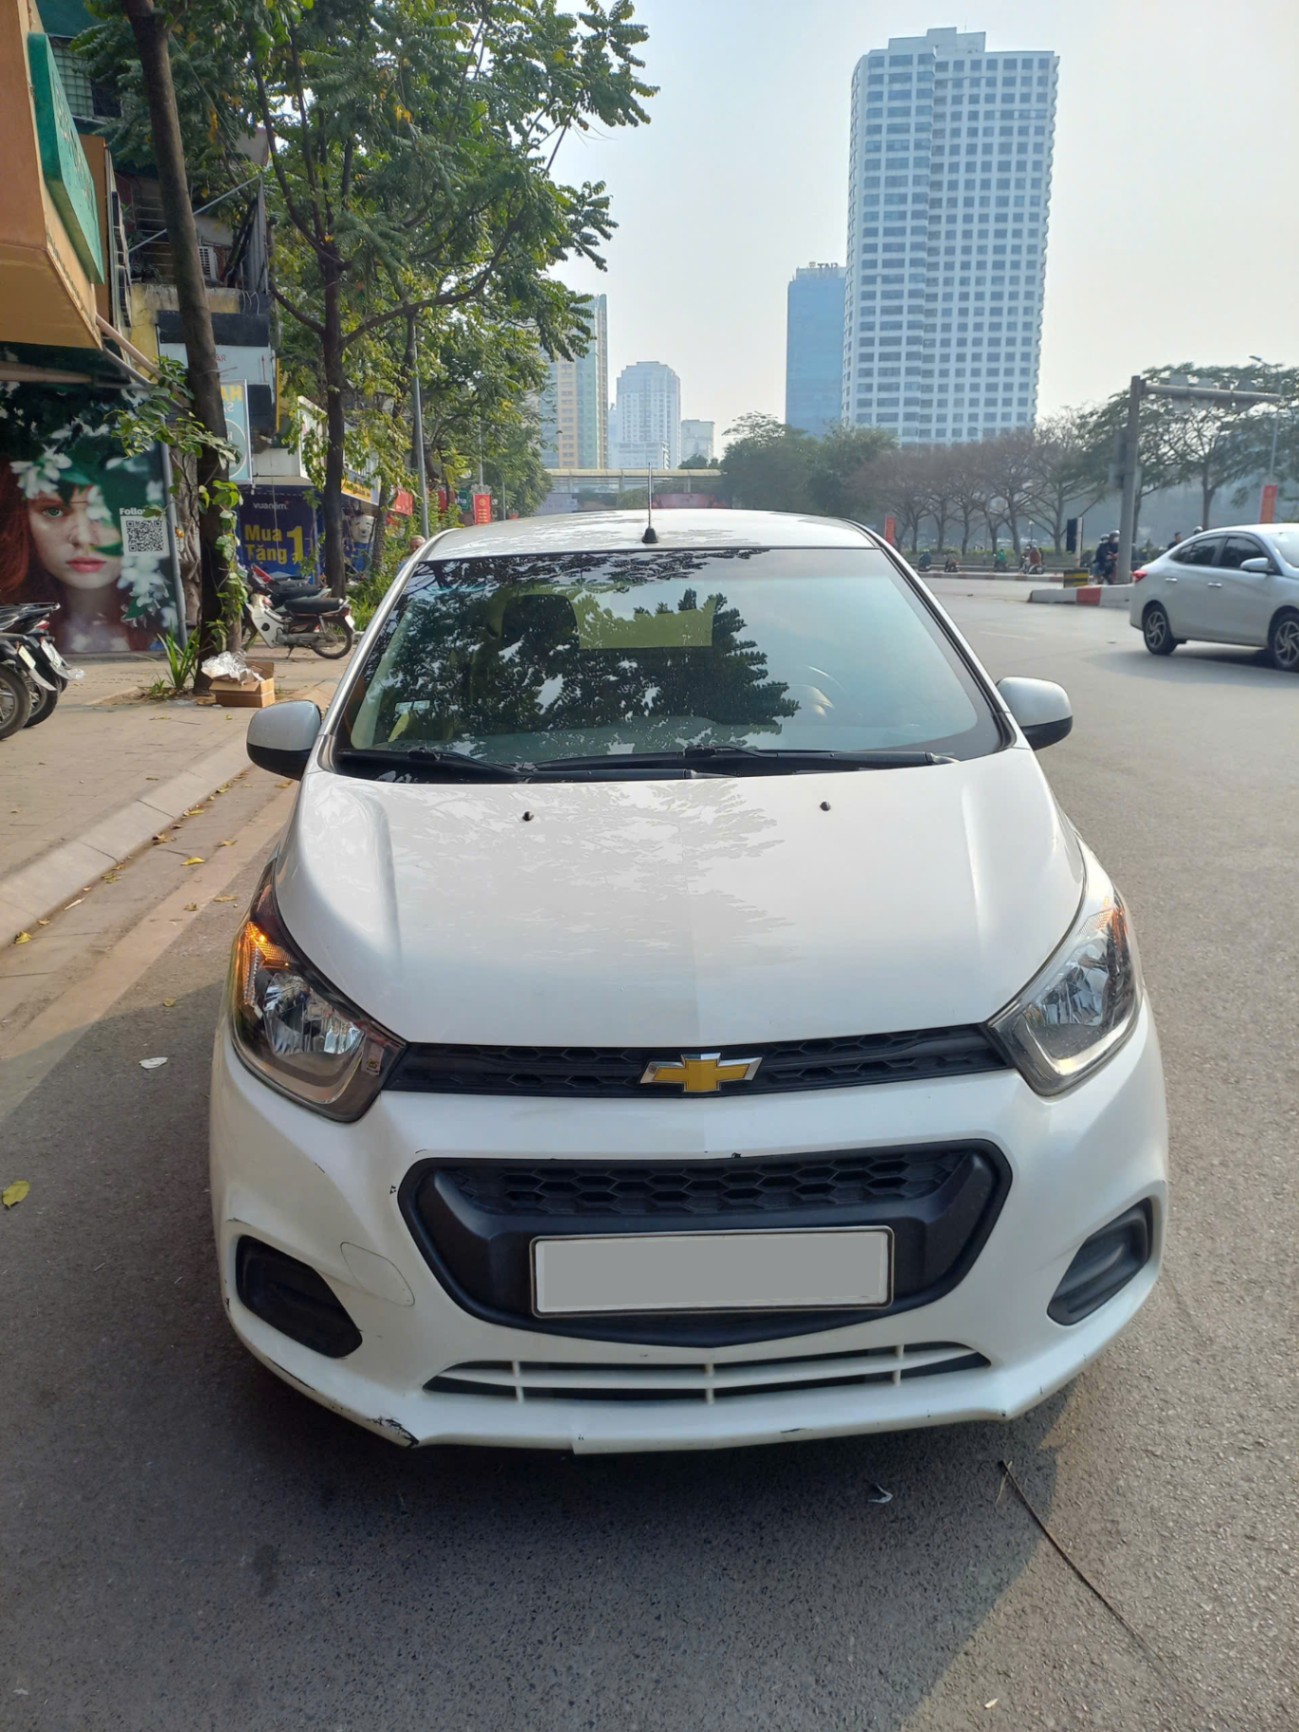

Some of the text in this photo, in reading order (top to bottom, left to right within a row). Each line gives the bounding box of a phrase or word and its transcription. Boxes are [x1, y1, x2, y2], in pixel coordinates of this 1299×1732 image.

[119, 507, 145, 515] Follo
[245, 525, 282, 541] Mua
[287, 526, 304, 562] 1
[246, 543, 287, 565] Tặng
